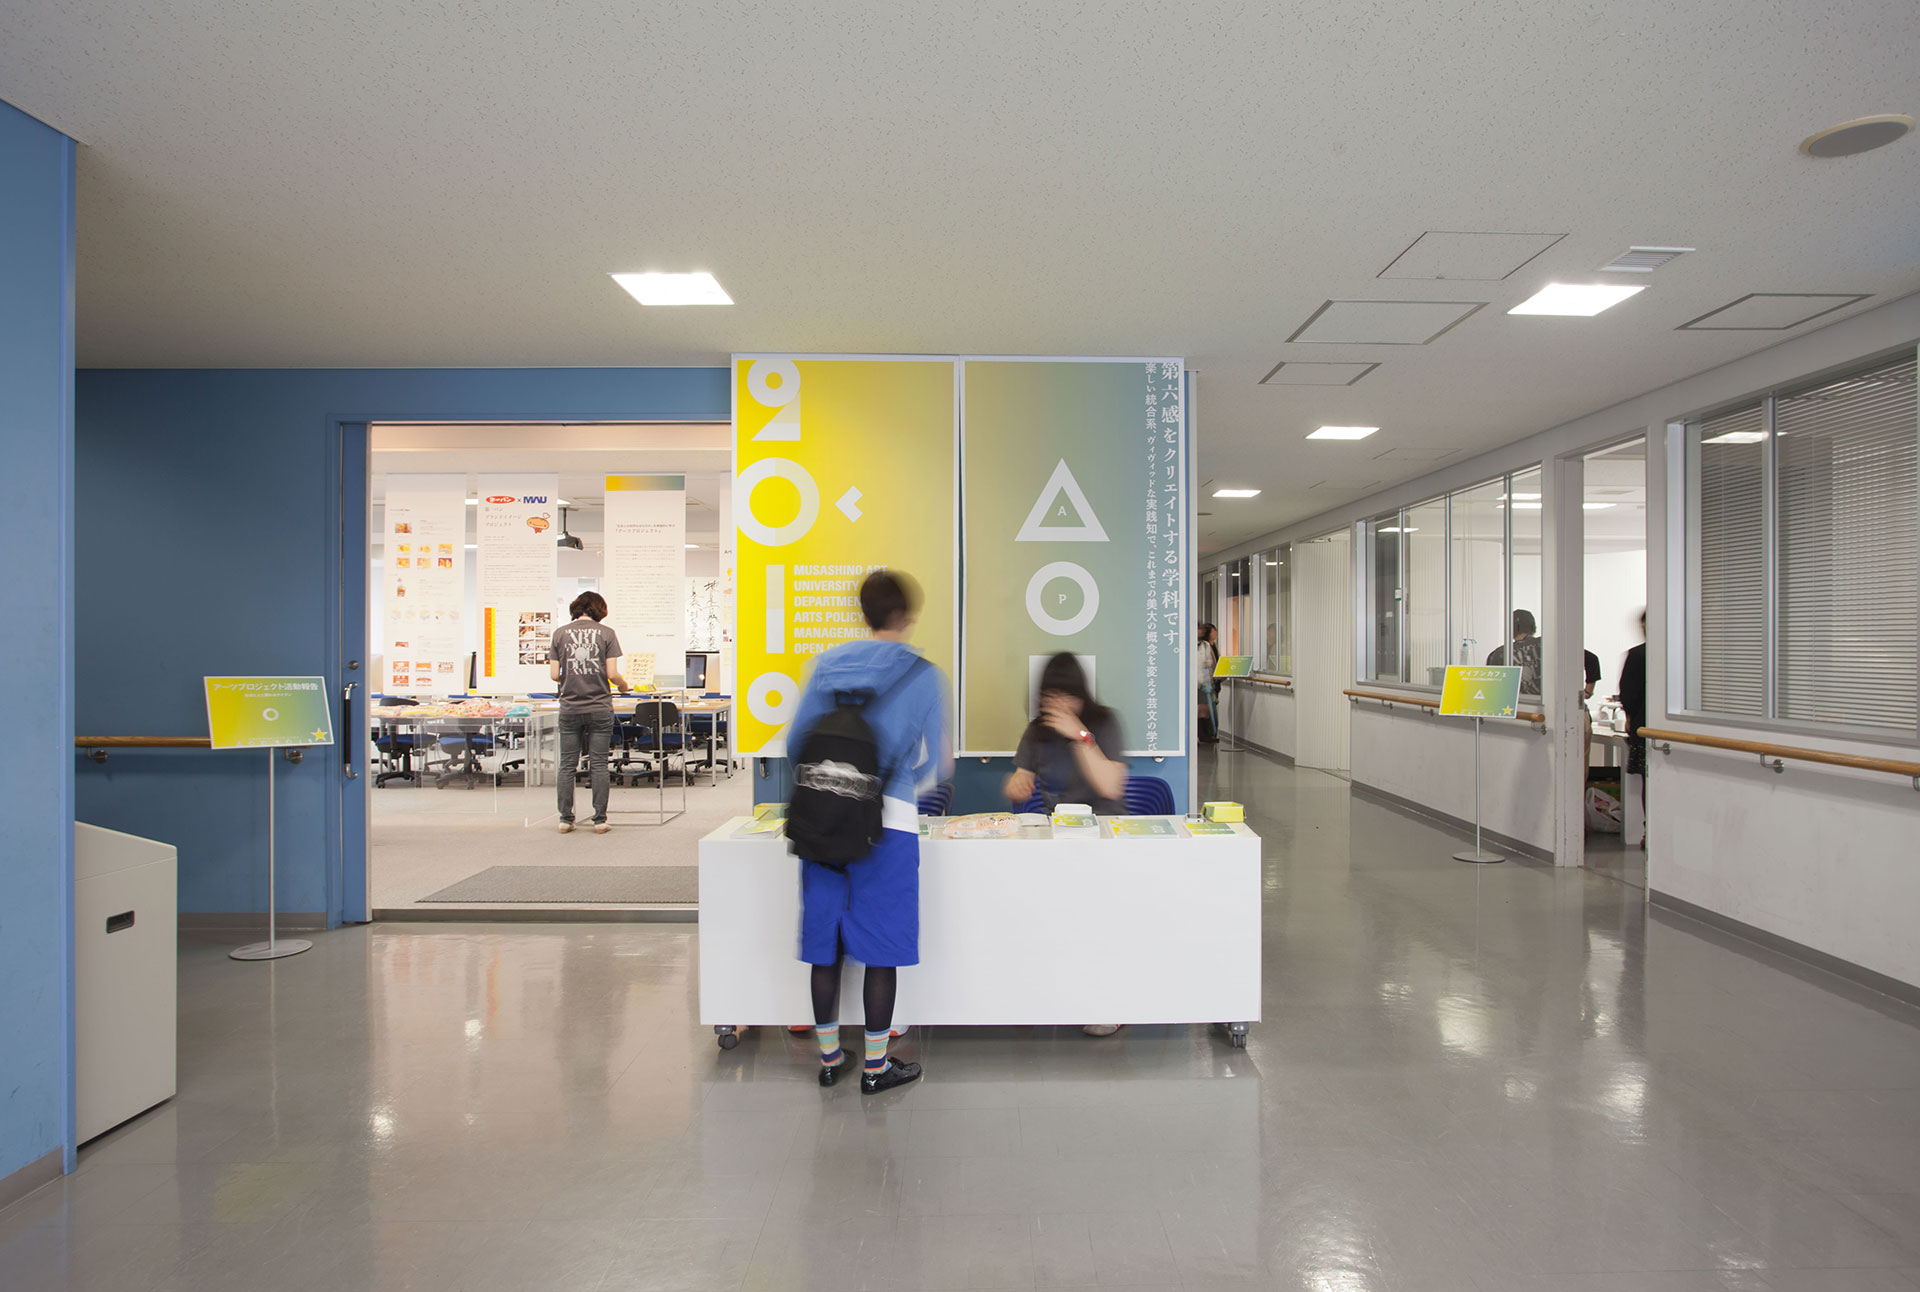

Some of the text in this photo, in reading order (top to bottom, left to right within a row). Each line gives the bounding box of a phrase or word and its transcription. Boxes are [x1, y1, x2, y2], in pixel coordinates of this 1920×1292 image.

[1057, 505, 1068, 516] A
[1160, 362, 1180, 654] 第六感をクリエイトする学科です。
[793, 564, 863, 576] MUSASHINO
[793, 580, 860, 591] UNIVERSITY
[793, 596, 862, 607] DEPARTMEN
[1058, 593, 1067, 605] P
[793, 612, 864, 623] ARTS POLICY
[793, 643, 824, 654] OPEN
